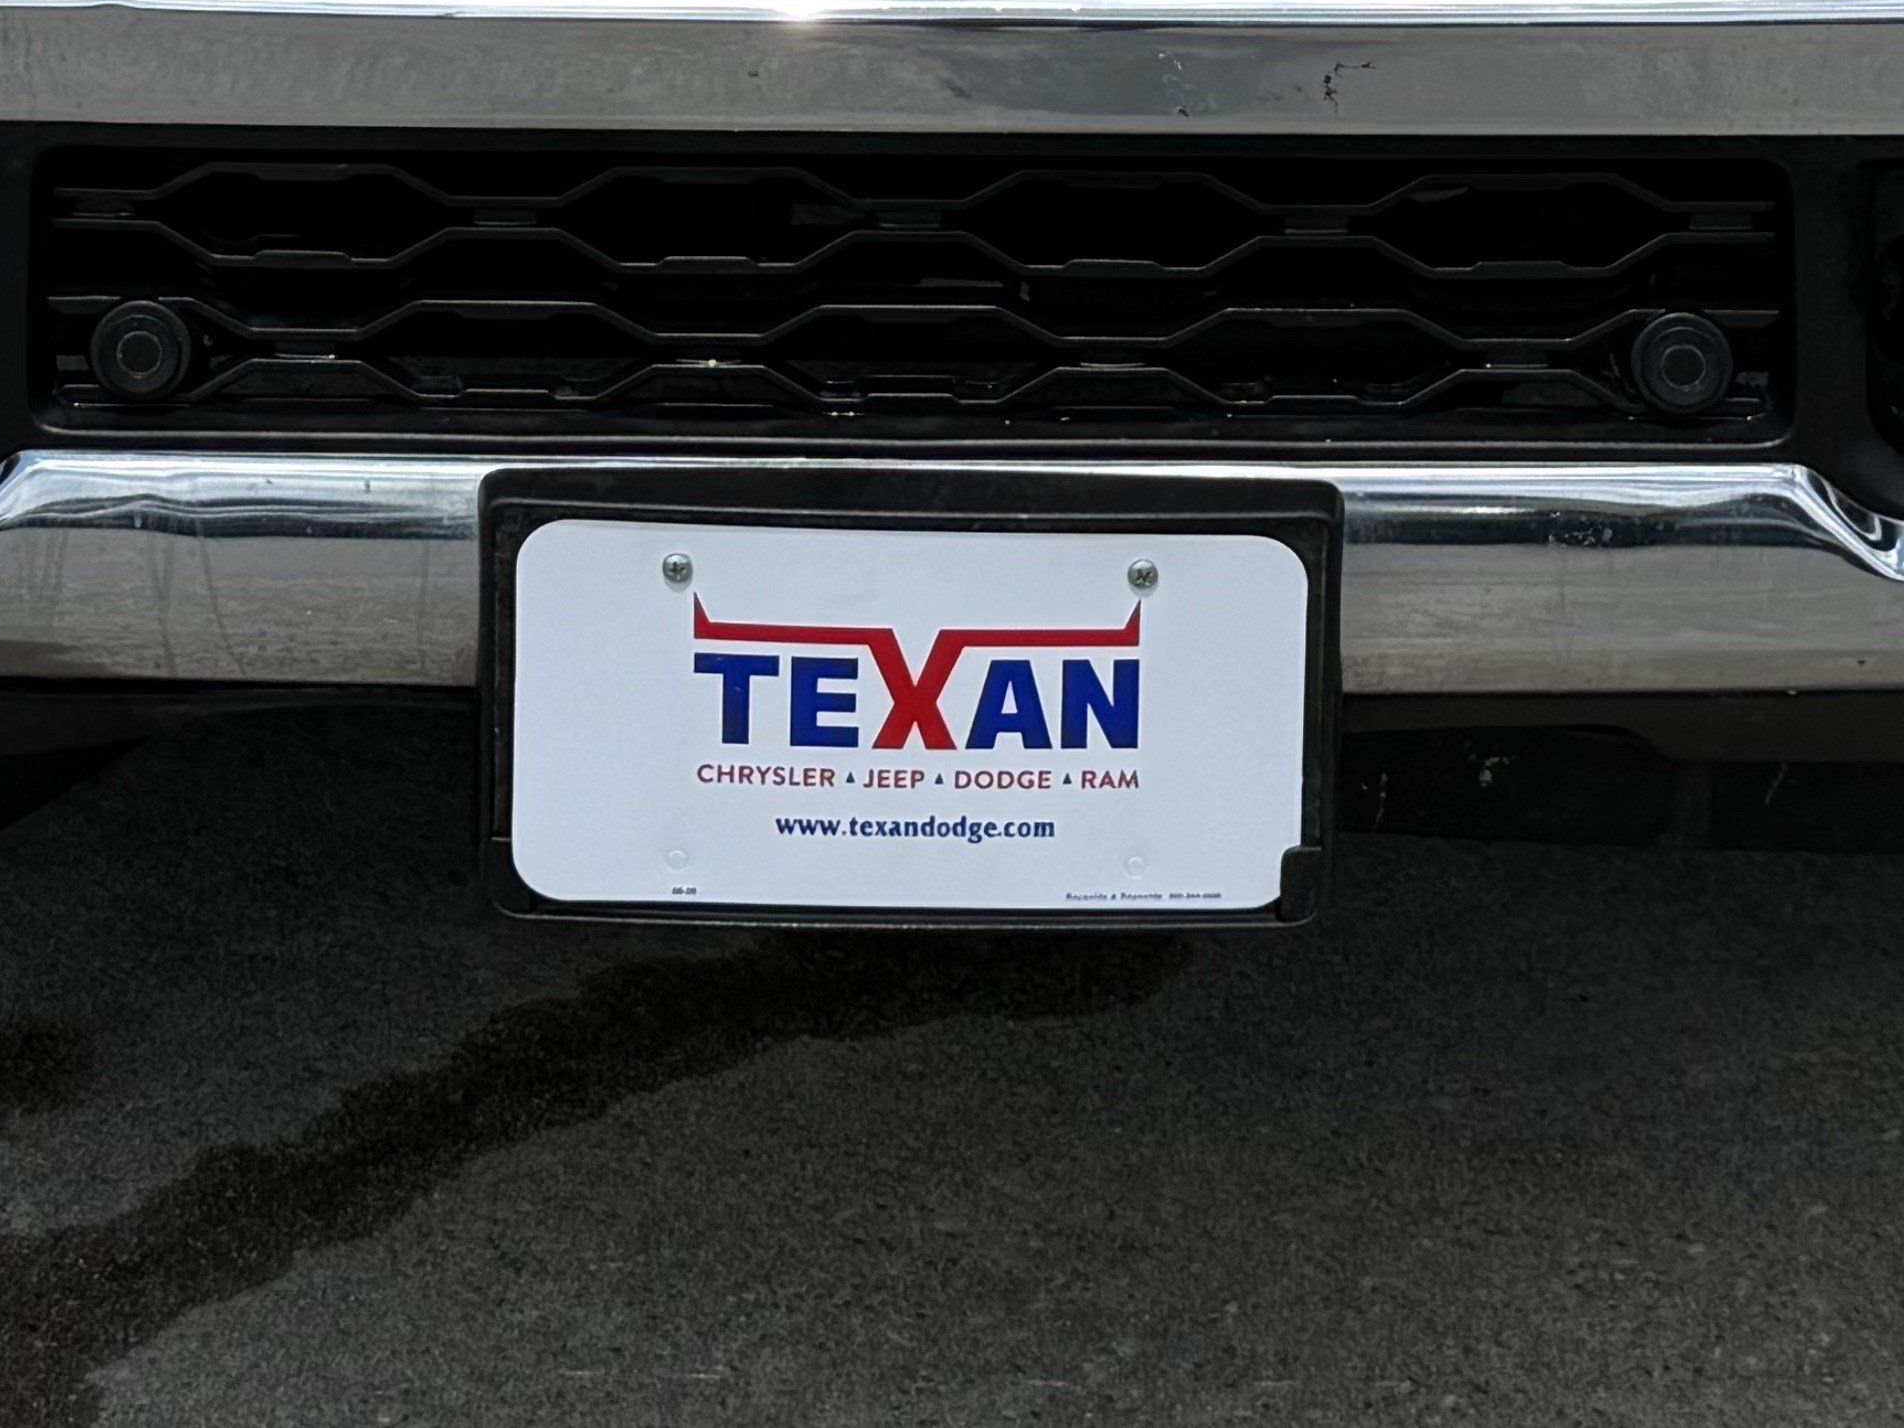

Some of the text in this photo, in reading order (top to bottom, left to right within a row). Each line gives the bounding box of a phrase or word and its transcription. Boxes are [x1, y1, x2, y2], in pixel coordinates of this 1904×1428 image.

[694, 628, 1139, 750] TEXAN
[696, 763, 1140, 790] CHRYSLER JEEP DODGE RAM
[775, 815, 1056, 844] www.texandodge.com
